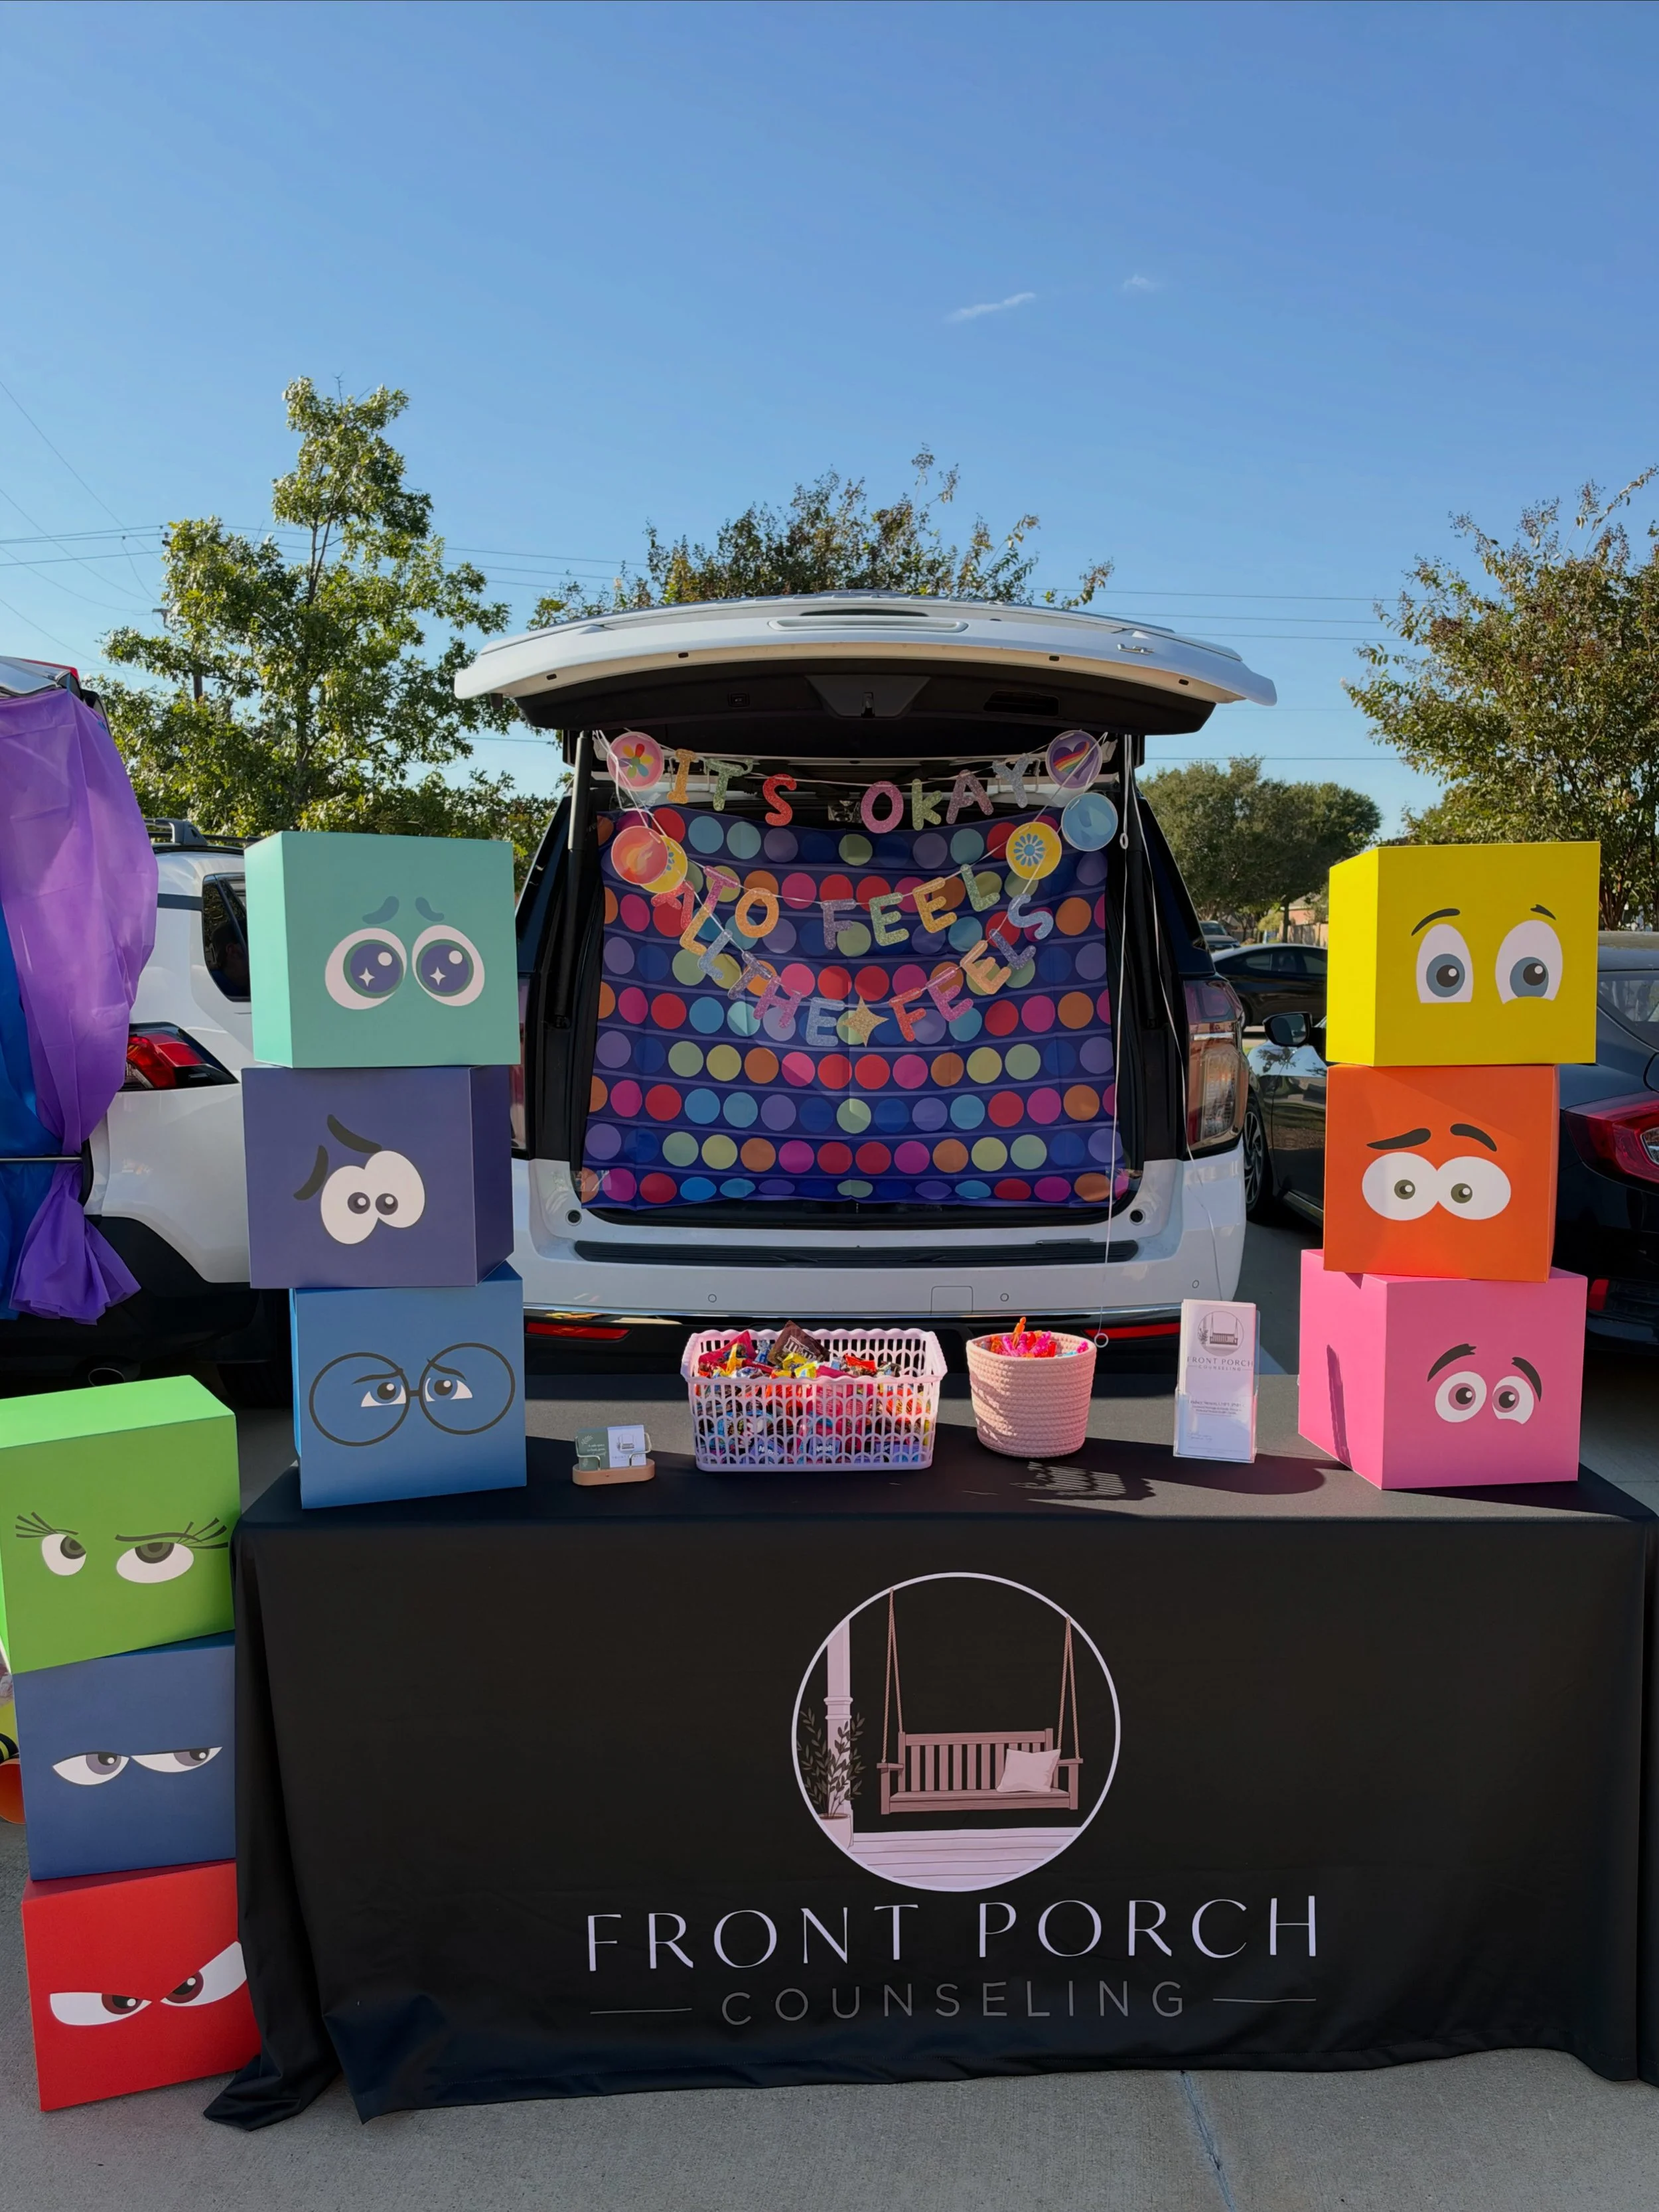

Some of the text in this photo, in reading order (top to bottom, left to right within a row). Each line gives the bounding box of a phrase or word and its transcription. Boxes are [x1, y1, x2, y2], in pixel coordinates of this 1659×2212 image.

[861, 753, 1029, 834] OKAY
[703, 864, 1000, 950] TO FEEL
[727, 951, 845, 1047] THE
[889, 893, 1054, 1042] FEELS
[1221, 1359, 1254, 1367] PORCH
[588, 1895, 1317, 1972] FRONT PORCH
[721, 1980, 1184, 2026] COUNSELING
